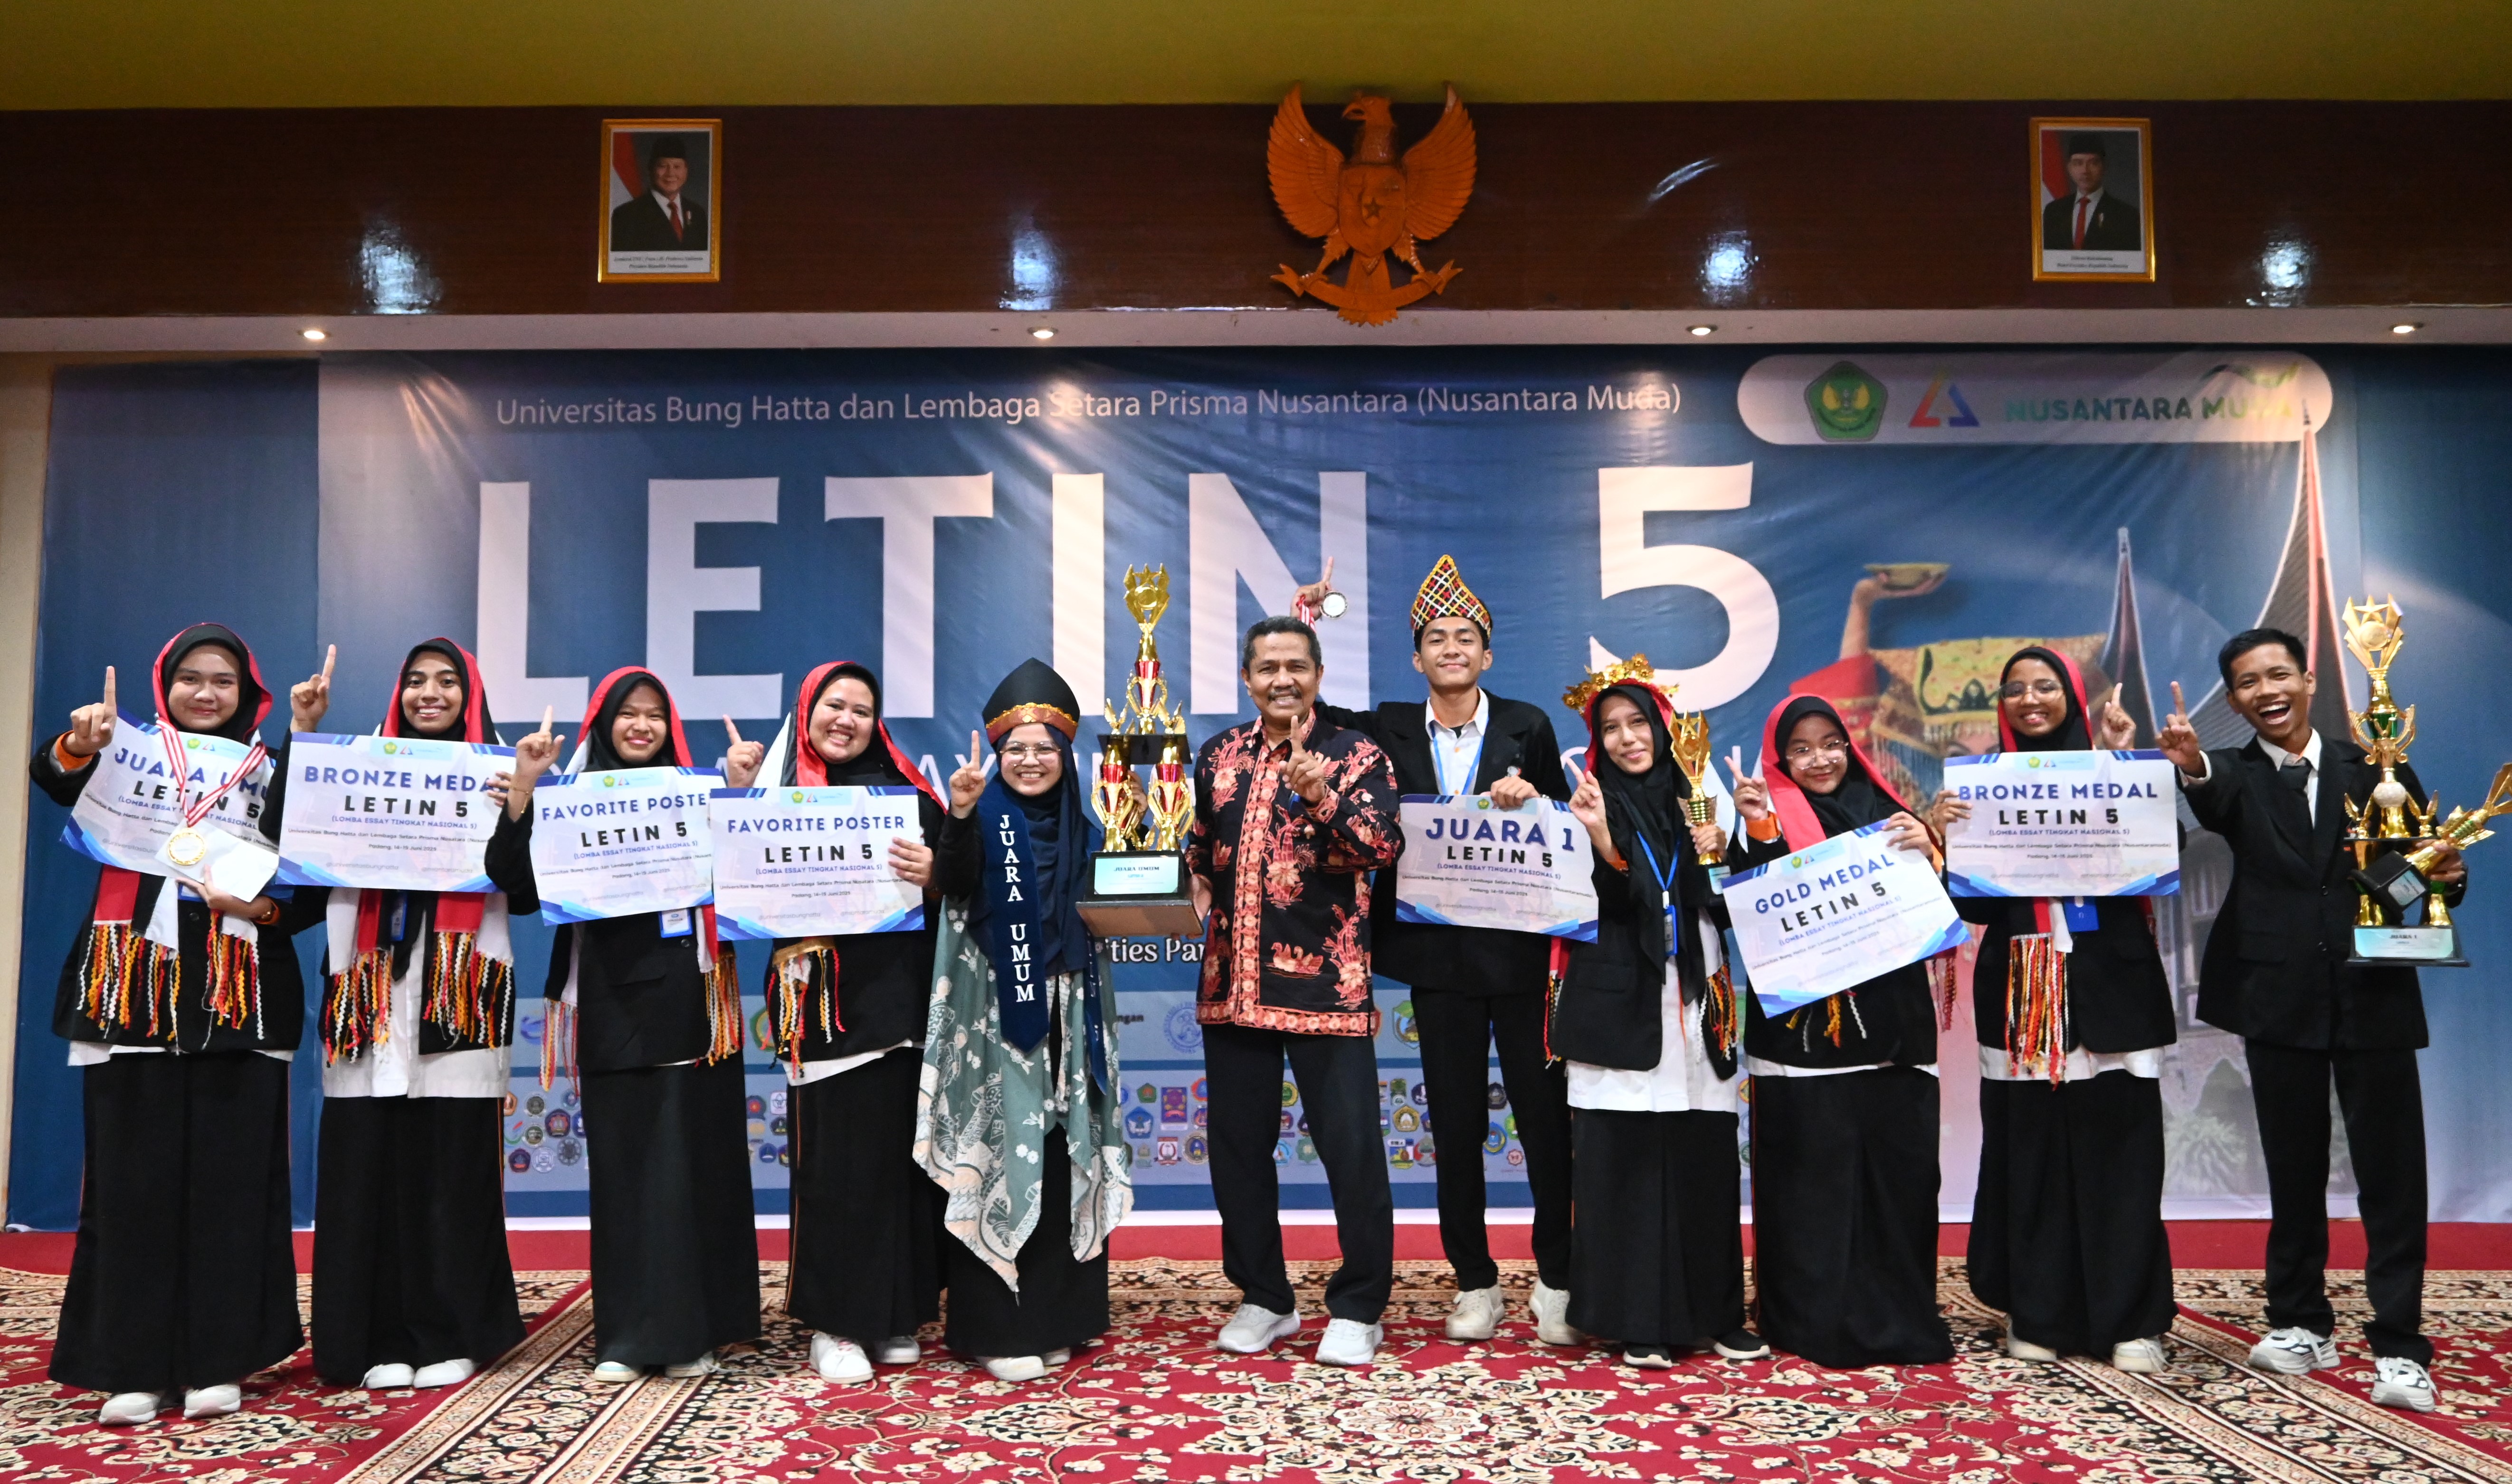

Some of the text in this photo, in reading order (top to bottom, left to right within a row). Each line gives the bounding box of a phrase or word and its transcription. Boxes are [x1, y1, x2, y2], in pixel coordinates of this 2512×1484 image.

[497, 384, 1681, 428] Universitas Bung Hatta dan Lembaga Setara Prisma Nusantara (Nusantara Muda)
[2005, 397, 2192, 421] NUSANTARA
[477, 462, 1780, 724] LETIN 5
[305, 766, 412, 788] BRONZE
[1959, 783, 2158, 801] BRONZE MEDAL
[119, 795, 257, 830] (LOMBA ESSAY NASIONAL
[247, 803, 260, 818] 5
[344, 795, 468, 817] LETIN 5
[542, 793, 707, 821] FAVORITE POSTE
[1999, 808, 2119, 825] LETIN 5
[581, 822, 687, 848] LETIN 5
[727, 816, 905, 833] FAVORITE POSTER
[1426, 818, 1574, 851] JUARA 1
[574, 851, 600, 860] (LOMBA
[625, 845, 654, 853] TINGKAT
[765, 844, 873, 863] LETIN 5
[1447, 846, 1552, 868] LETIN 5
[1519, 869, 1553, 878] NASIONAL
[1755, 854, 1895, 914] GOLD MEDAL
[1000, 814, 1035, 1002] JUARA UMUM
[1780, 882, 1886, 932] LETIN 5
[1779, 934, 1804, 946] (LOMBA
[1806, 925, 1826, 936] ESSAY
[1827, 914, 1856, 927] TINGKAT
[1858, 899, 1894, 916] NASIONAL
